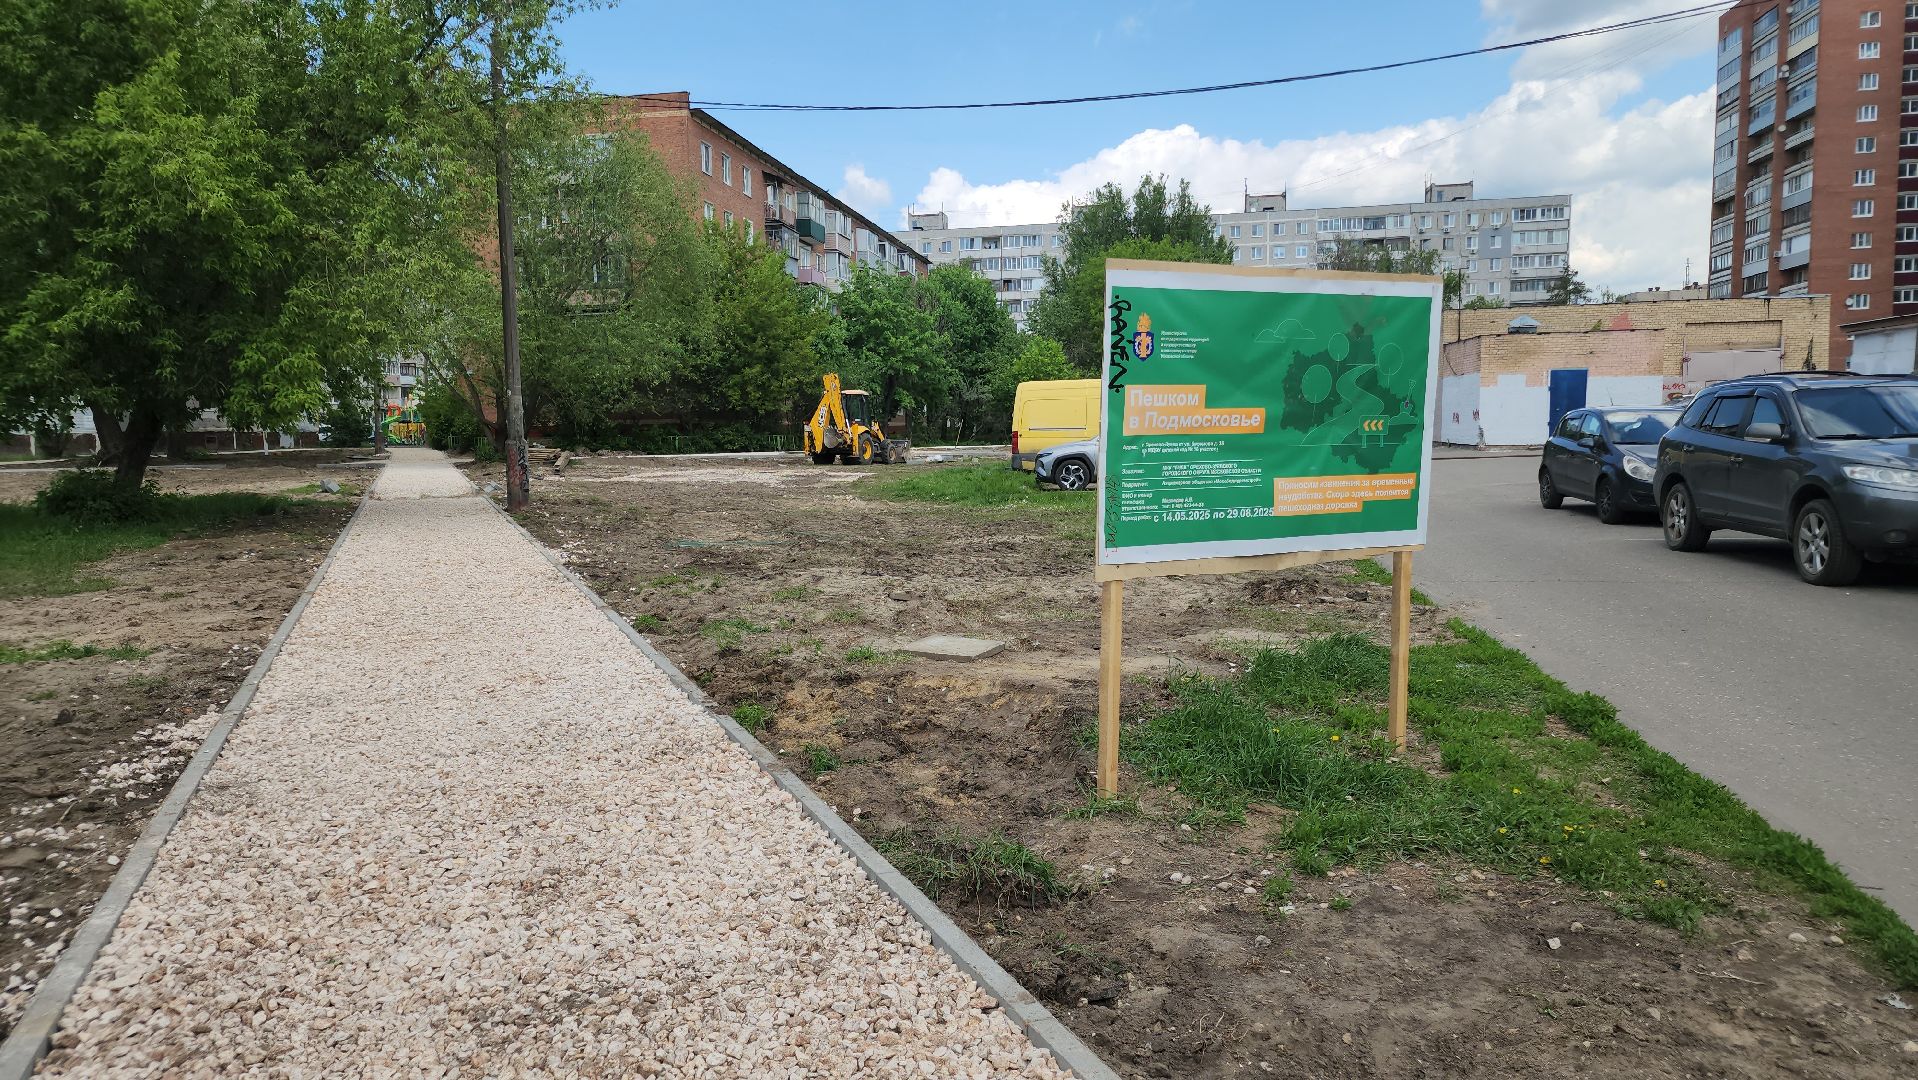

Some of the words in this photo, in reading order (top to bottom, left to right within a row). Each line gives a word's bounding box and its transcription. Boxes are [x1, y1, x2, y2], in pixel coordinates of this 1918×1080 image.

[1130, 389, 1199, 407] Пешком
[1129, 415, 1139, 429] в
[1144, 411, 1261, 431] Подмосковье
[1278, 480, 1319, 491] Приносим
[1371, 478, 1414, 488] временные
[1325, 490, 1350, 500] Скоро
[1350, 489, 1373, 499] здесь
[1161, 510, 1211, 522] 14.05.2025
[1212, 512, 1226, 520] по
[1226, 507, 1275, 519] 29.08.2025
